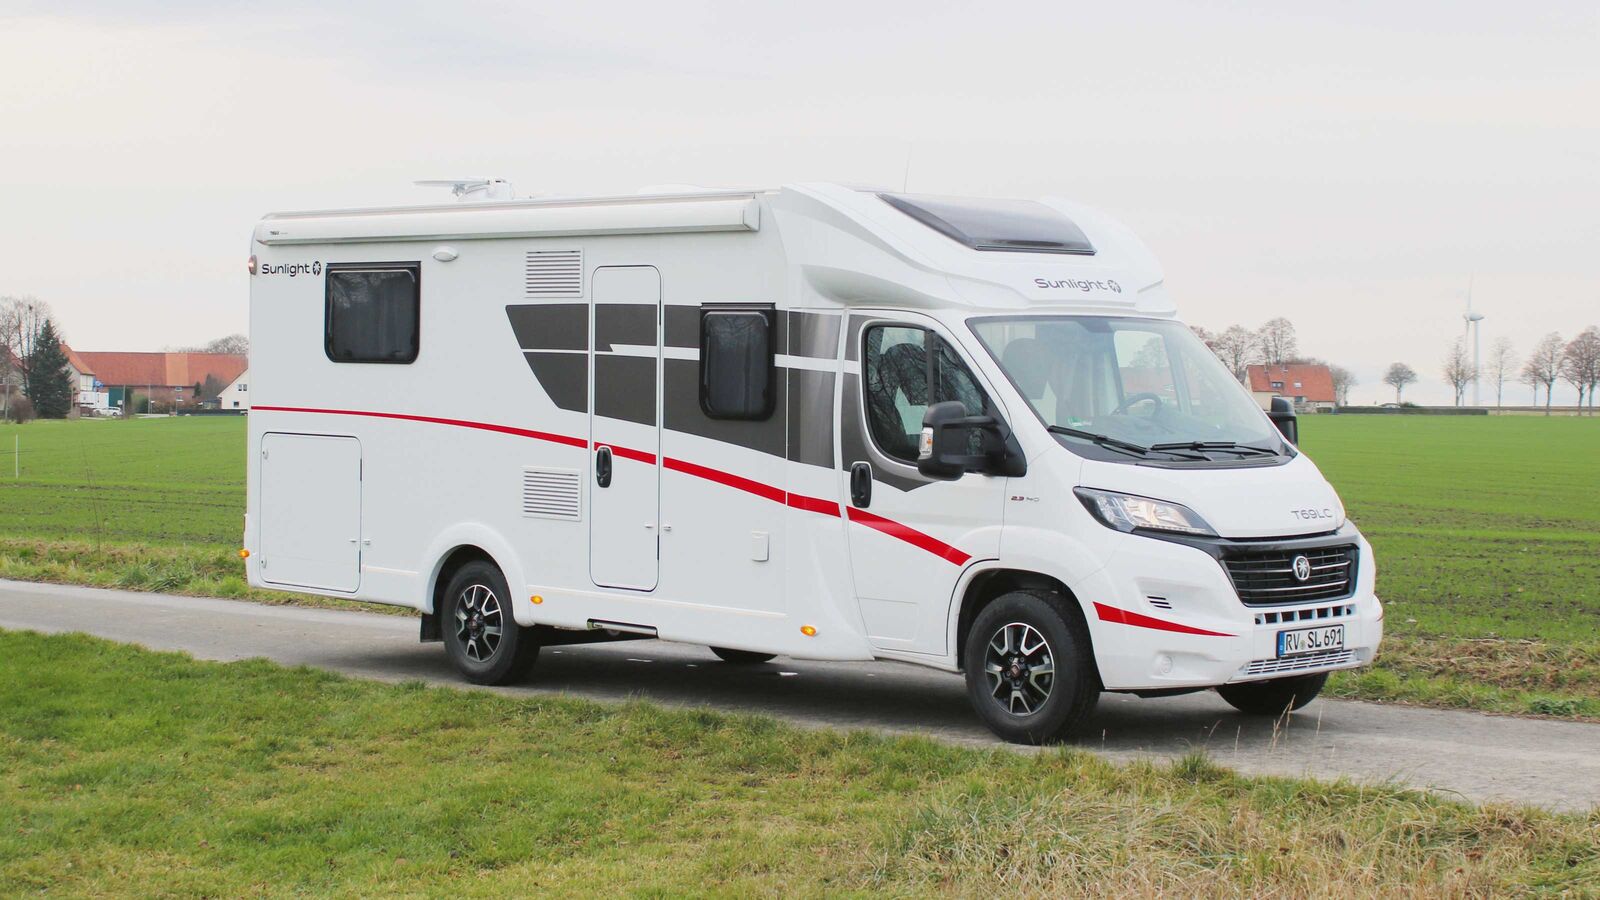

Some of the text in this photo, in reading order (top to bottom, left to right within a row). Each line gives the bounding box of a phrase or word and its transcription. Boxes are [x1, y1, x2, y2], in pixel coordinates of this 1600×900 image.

[262, 263, 310, 277] Sunlight
[1034, 278, 1108, 292] Sunlight
[1290, 508, 1333, 519] T69LC
[1285, 628, 1342, 651] RV SL 691
